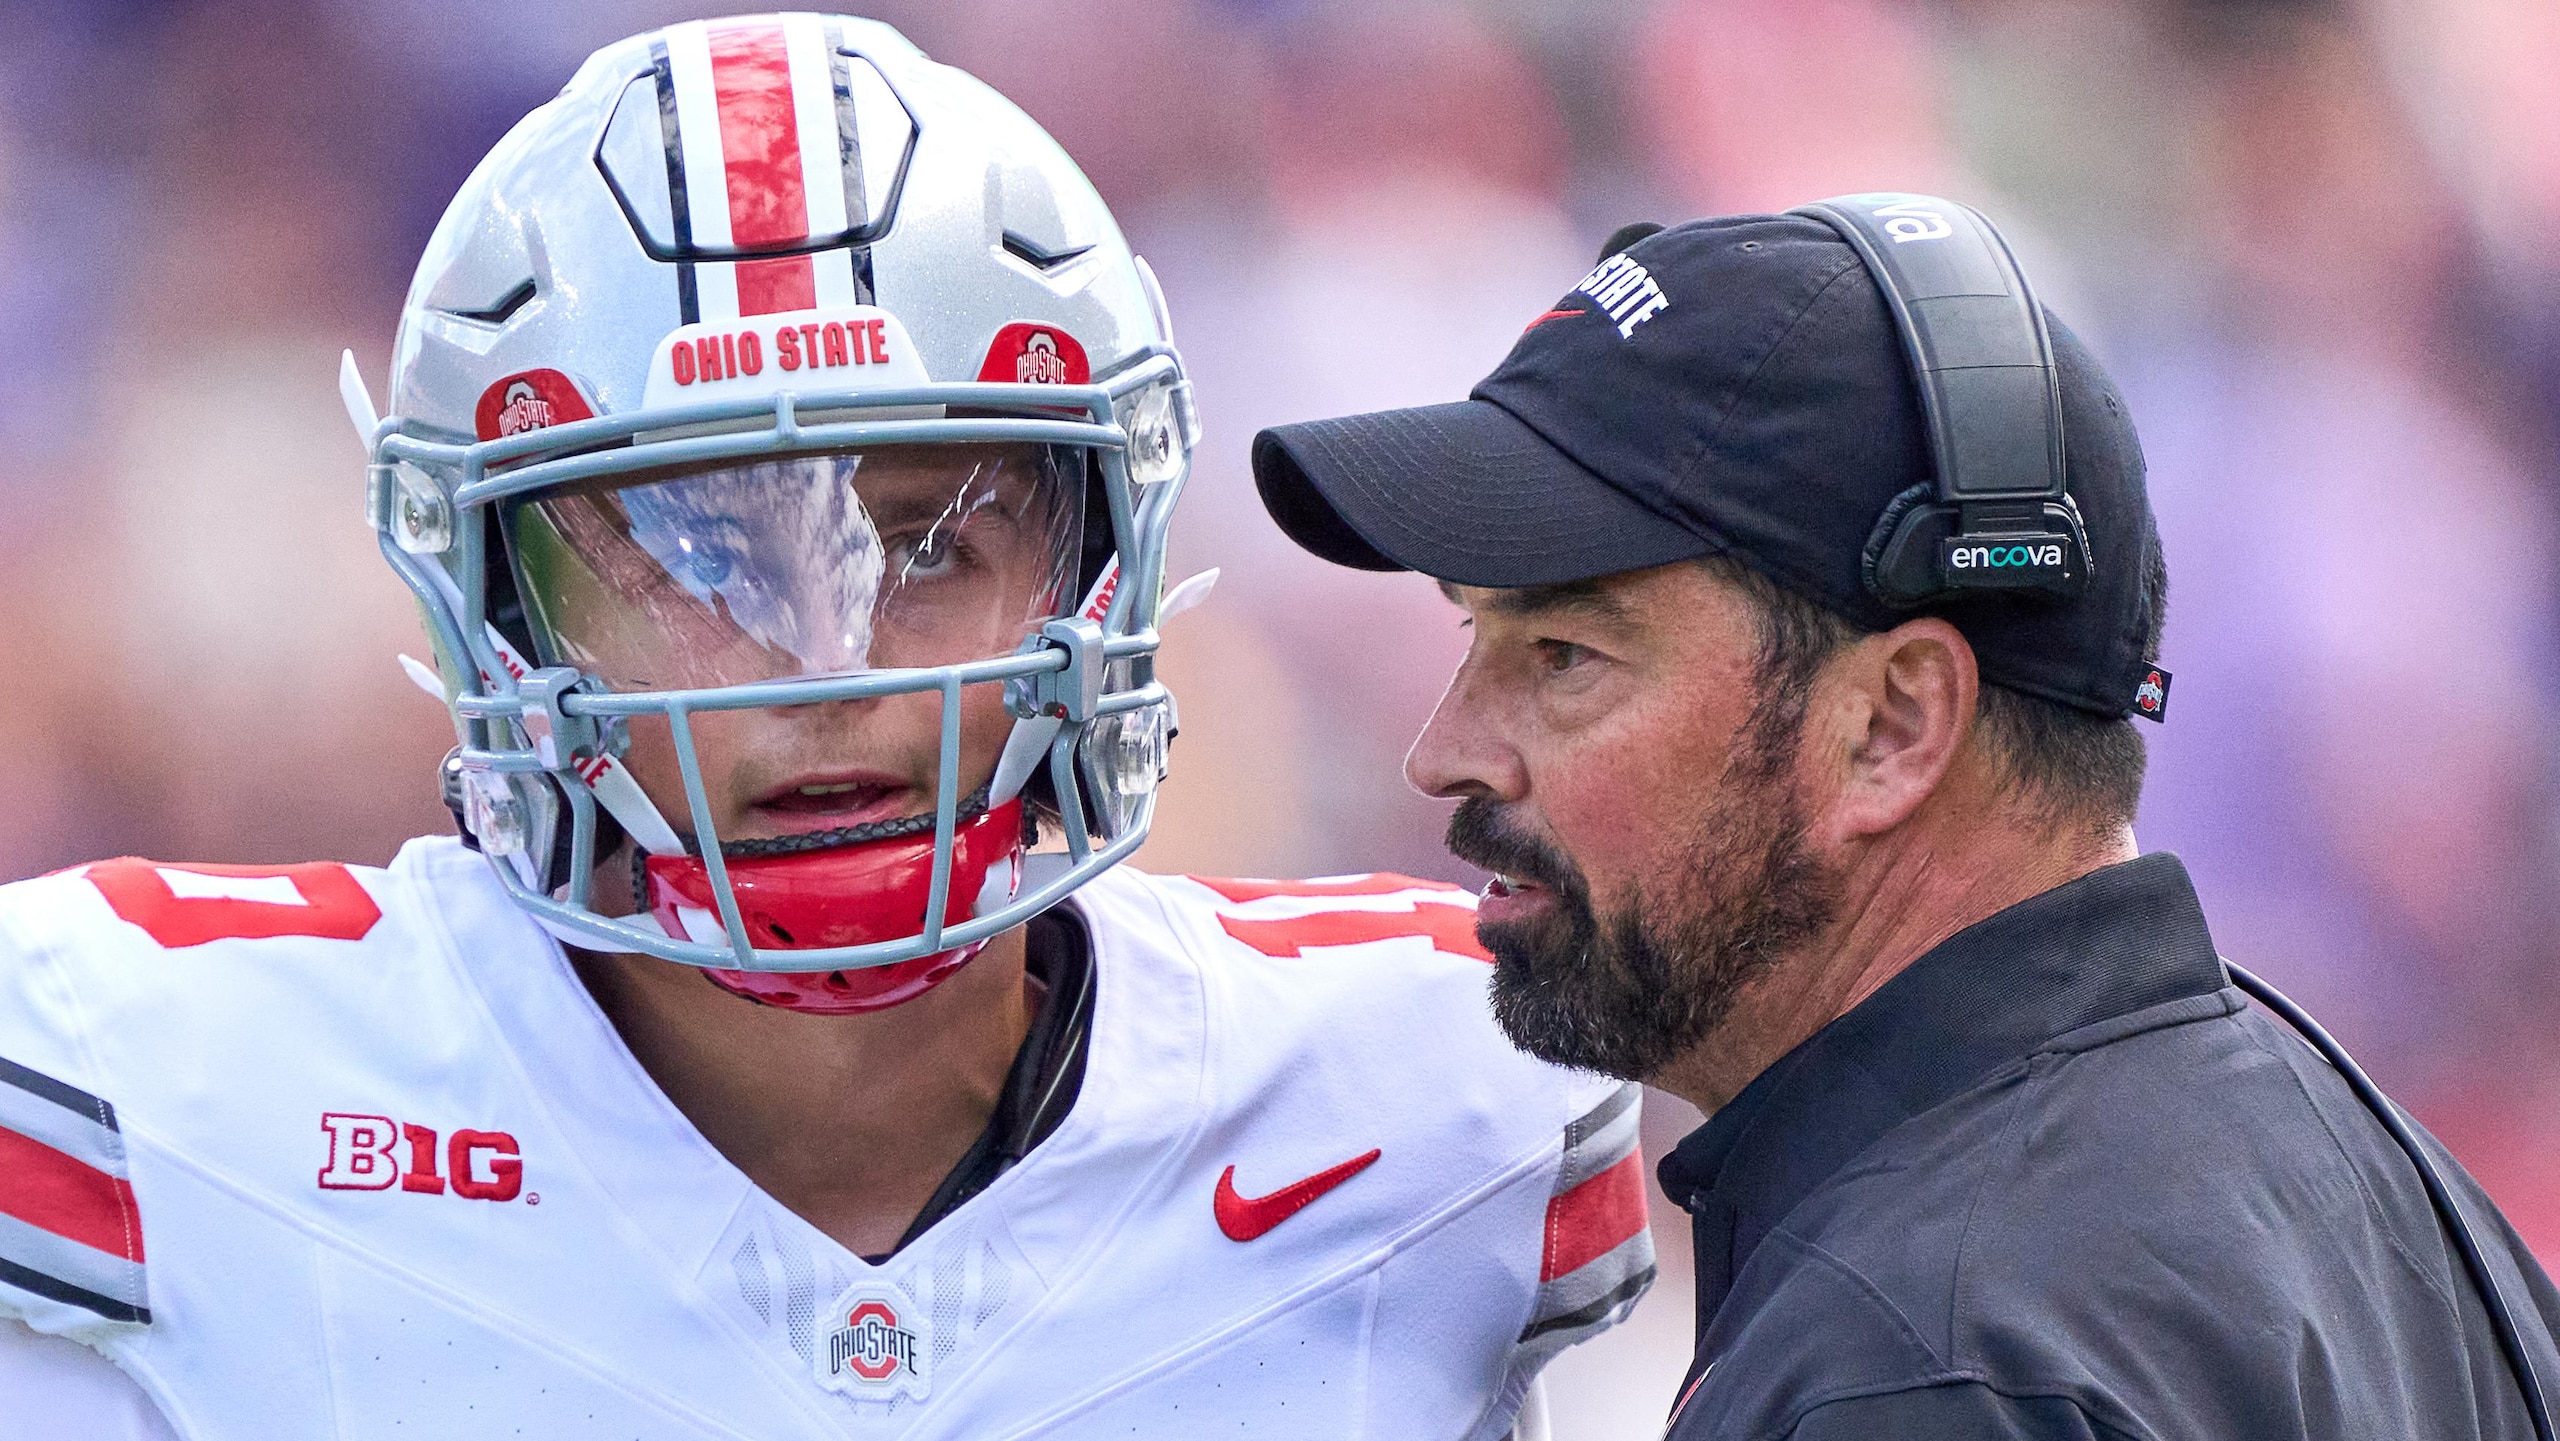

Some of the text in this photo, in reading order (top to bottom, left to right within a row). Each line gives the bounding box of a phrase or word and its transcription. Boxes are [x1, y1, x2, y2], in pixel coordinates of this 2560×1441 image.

[671, 318, 890, 386] OHIO STATE
[1951, 544, 2062, 568] encova
